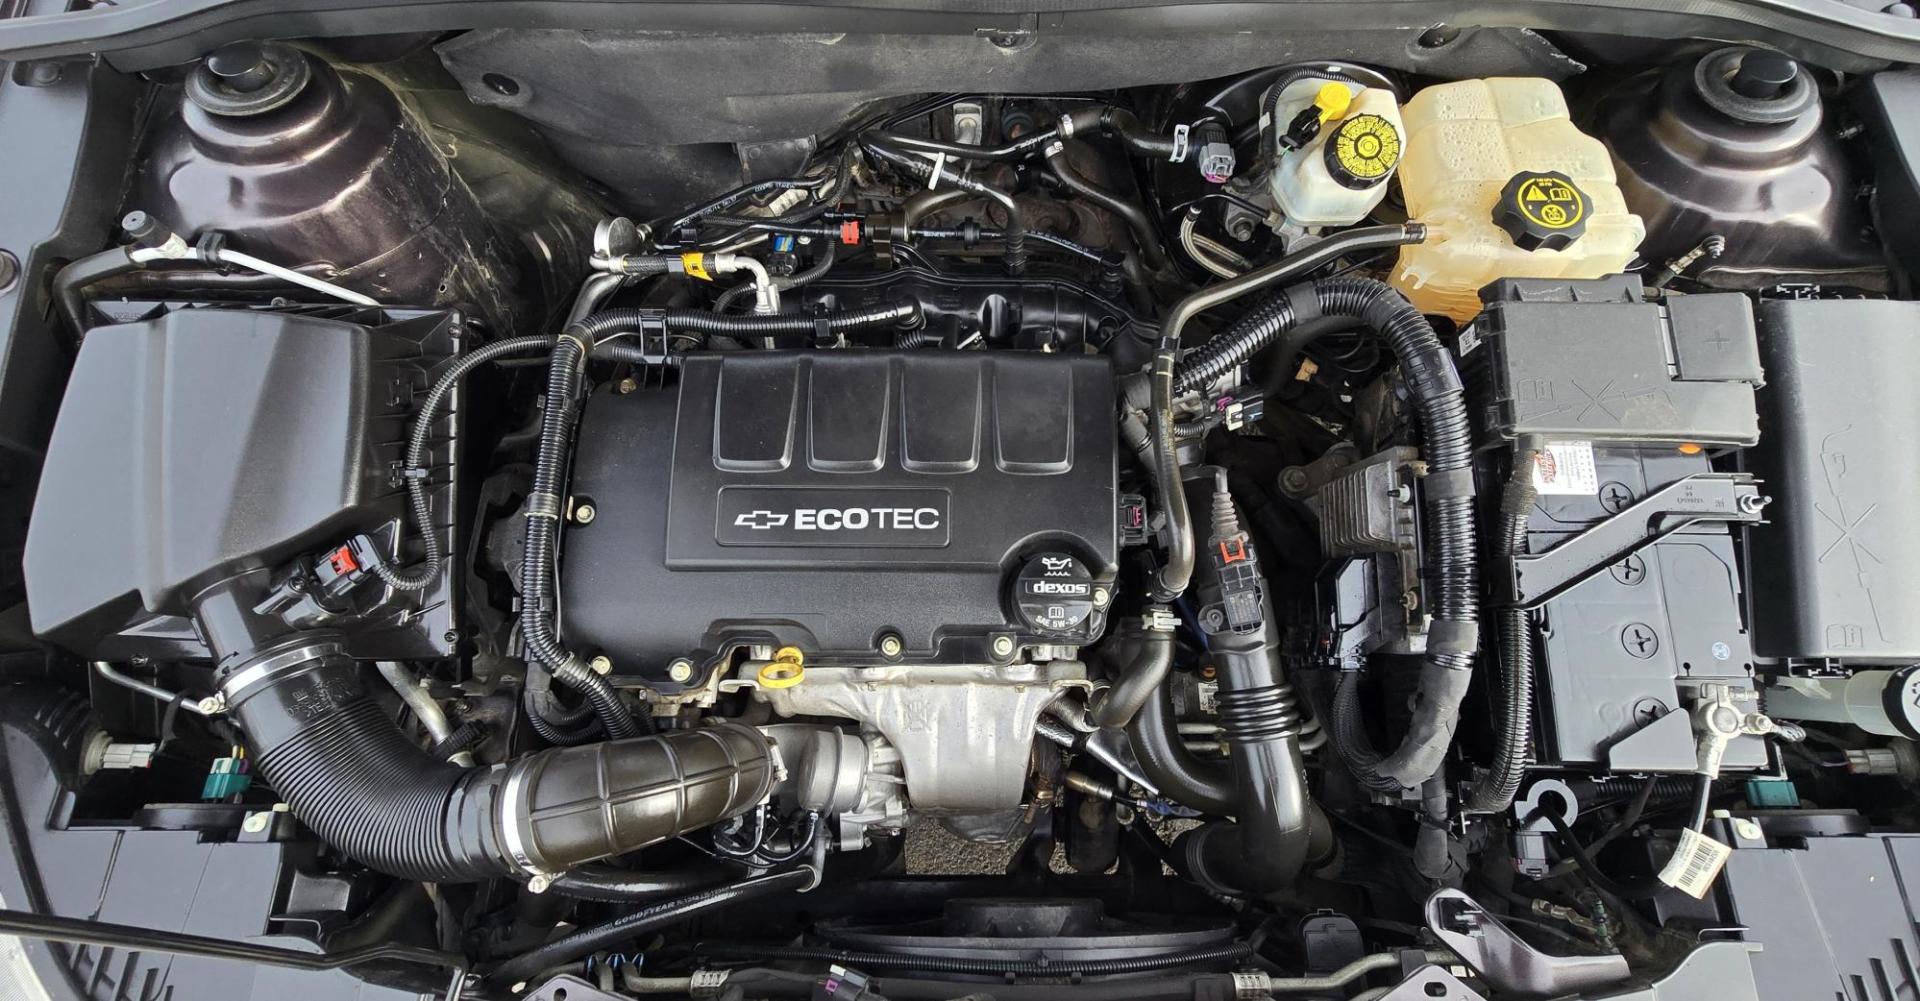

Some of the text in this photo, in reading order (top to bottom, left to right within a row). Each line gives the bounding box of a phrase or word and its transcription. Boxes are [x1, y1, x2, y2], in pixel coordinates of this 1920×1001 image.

[794, 507, 940, 531] ECOTEC
[1033, 580, 1088, 594] dexos
[1035, 615, 1079, 628] SAE 5W-30
[614, 901, 676, 926] GOODYEAR
